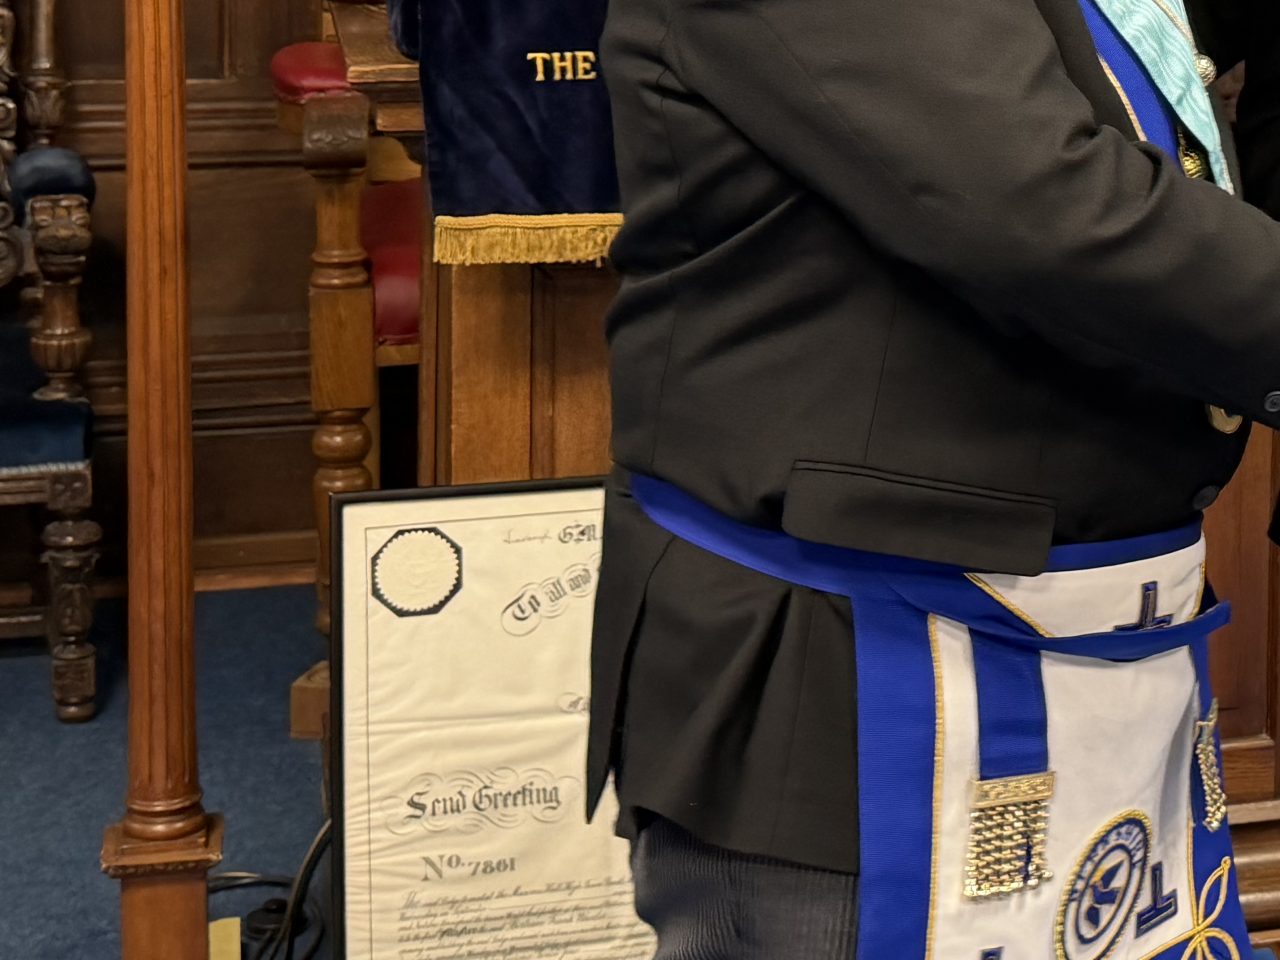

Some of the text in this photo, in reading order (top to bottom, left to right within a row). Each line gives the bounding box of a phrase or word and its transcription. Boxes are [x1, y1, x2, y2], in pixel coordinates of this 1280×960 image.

[526, 51, 597, 82] THE
[404, 781, 563, 820] Send Greeting
[467, 857, 516, 877] 7861
